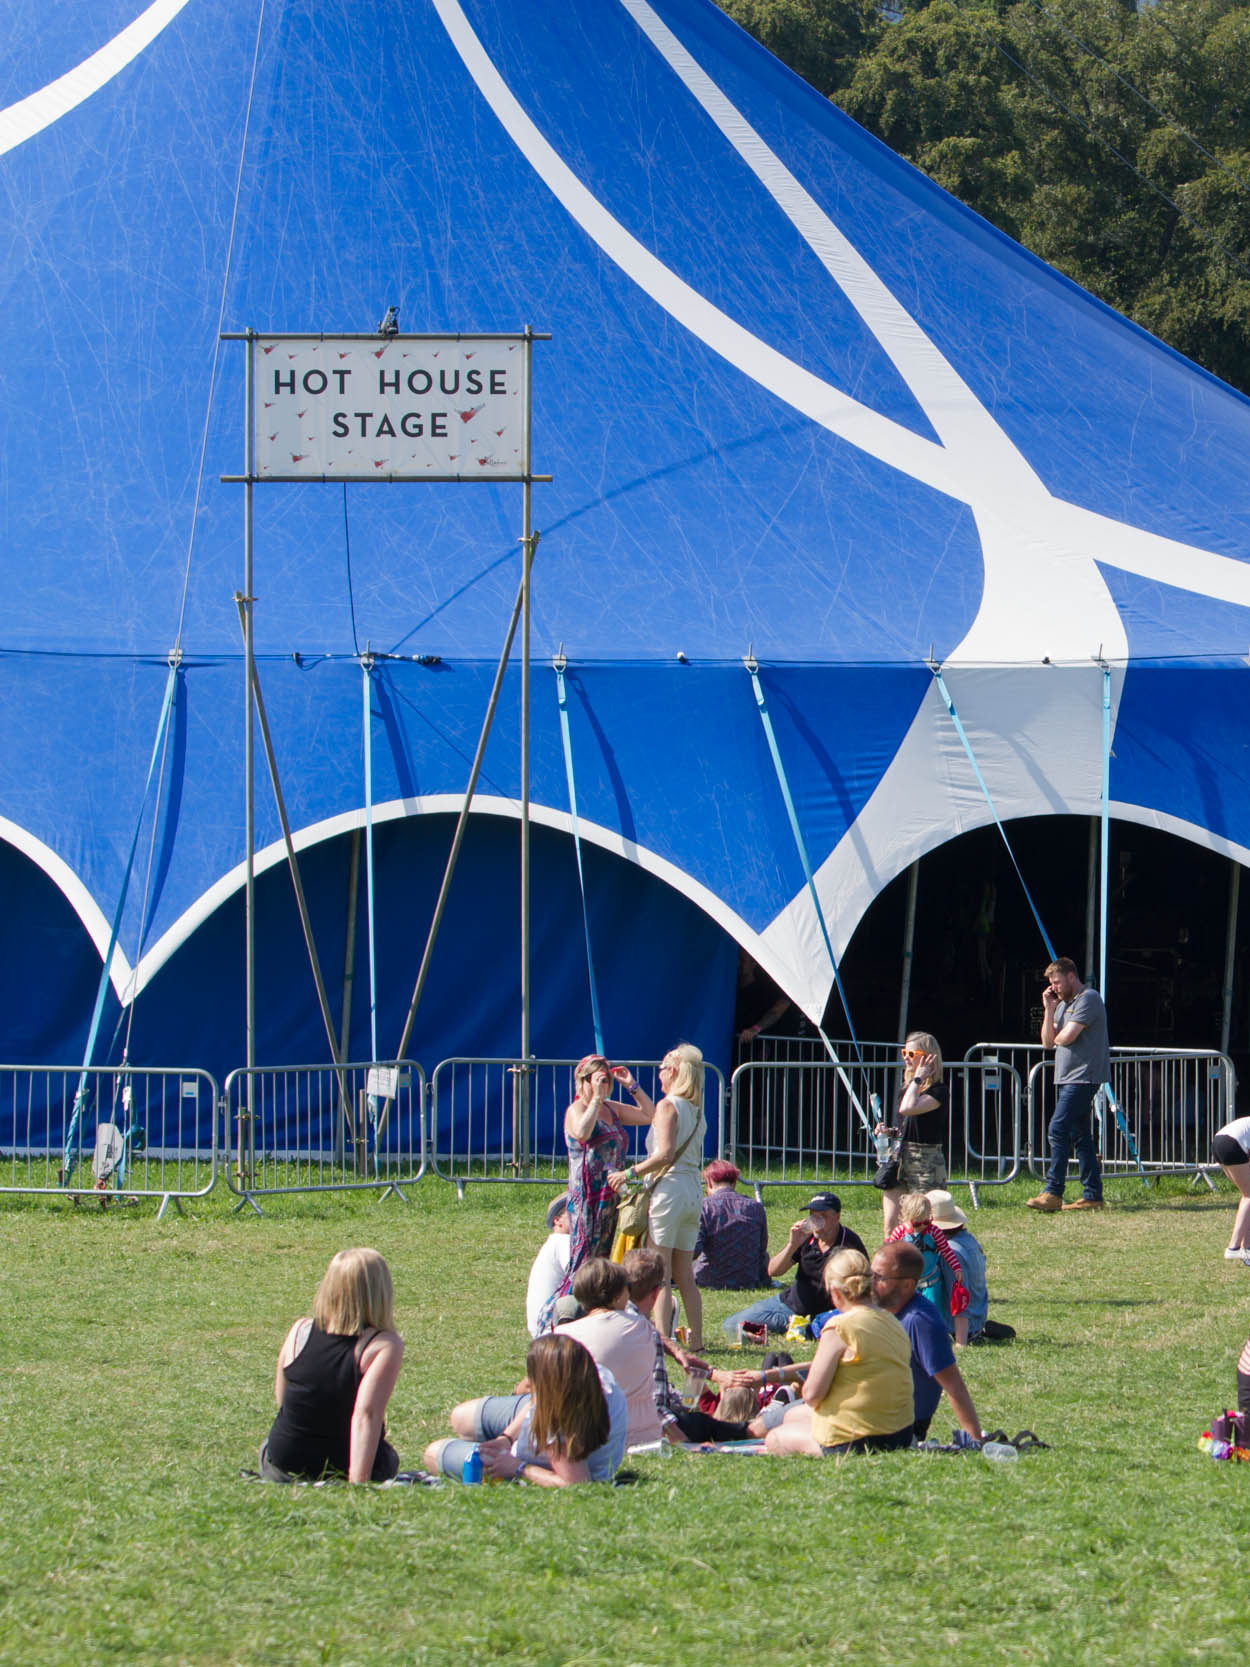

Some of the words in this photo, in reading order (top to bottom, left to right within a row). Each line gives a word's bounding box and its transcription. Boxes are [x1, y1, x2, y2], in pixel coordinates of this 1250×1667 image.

[274, 369, 352, 395] HOT
[379, 369, 507, 395] HOUSE
[331, 411, 449, 439] STAGE
